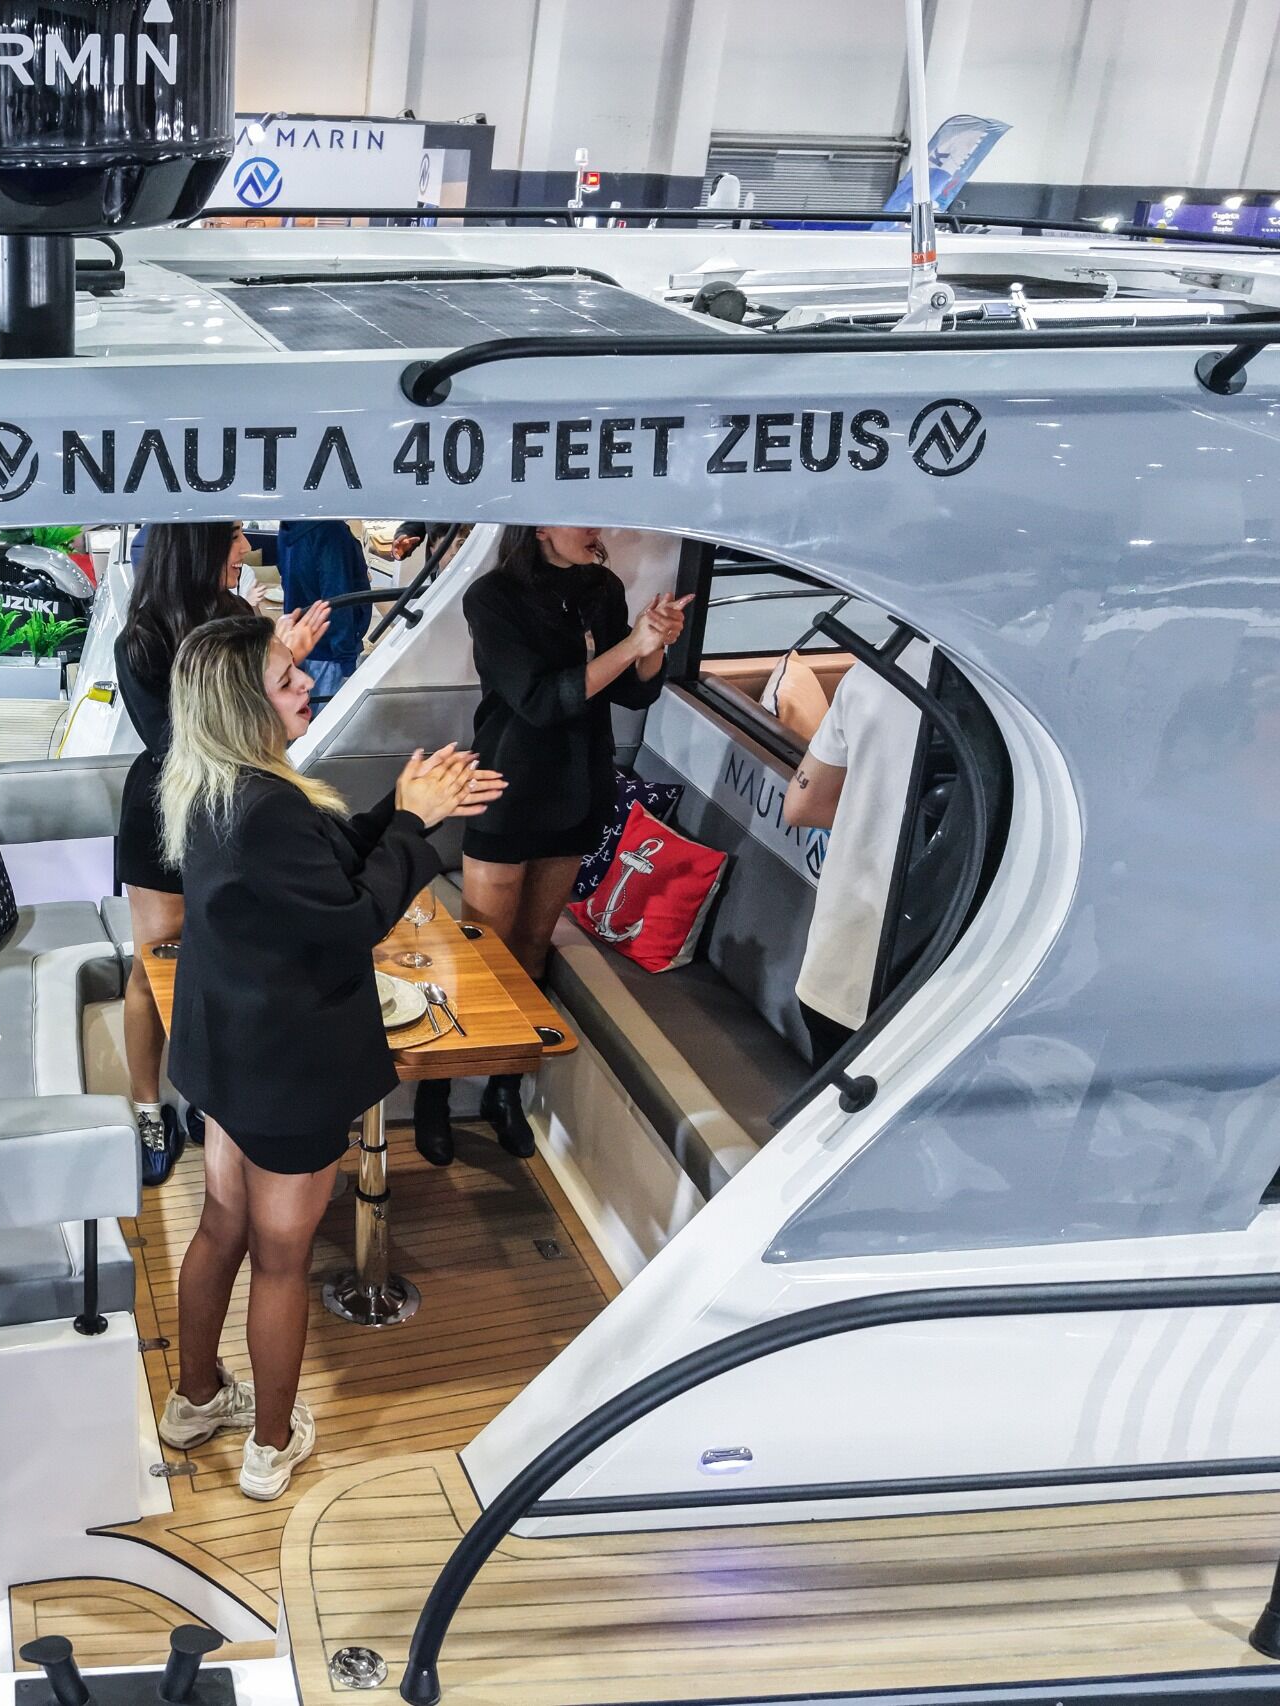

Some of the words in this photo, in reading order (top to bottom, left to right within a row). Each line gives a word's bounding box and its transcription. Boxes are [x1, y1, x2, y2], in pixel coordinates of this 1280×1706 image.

[276, 127, 384, 150] MARIN
[62, 426, 363, 495] NAUTA
[393, 418, 485, 486] 40
[511, 416, 686, 482] FEET
[706, 408, 890, 474] ZEUS
